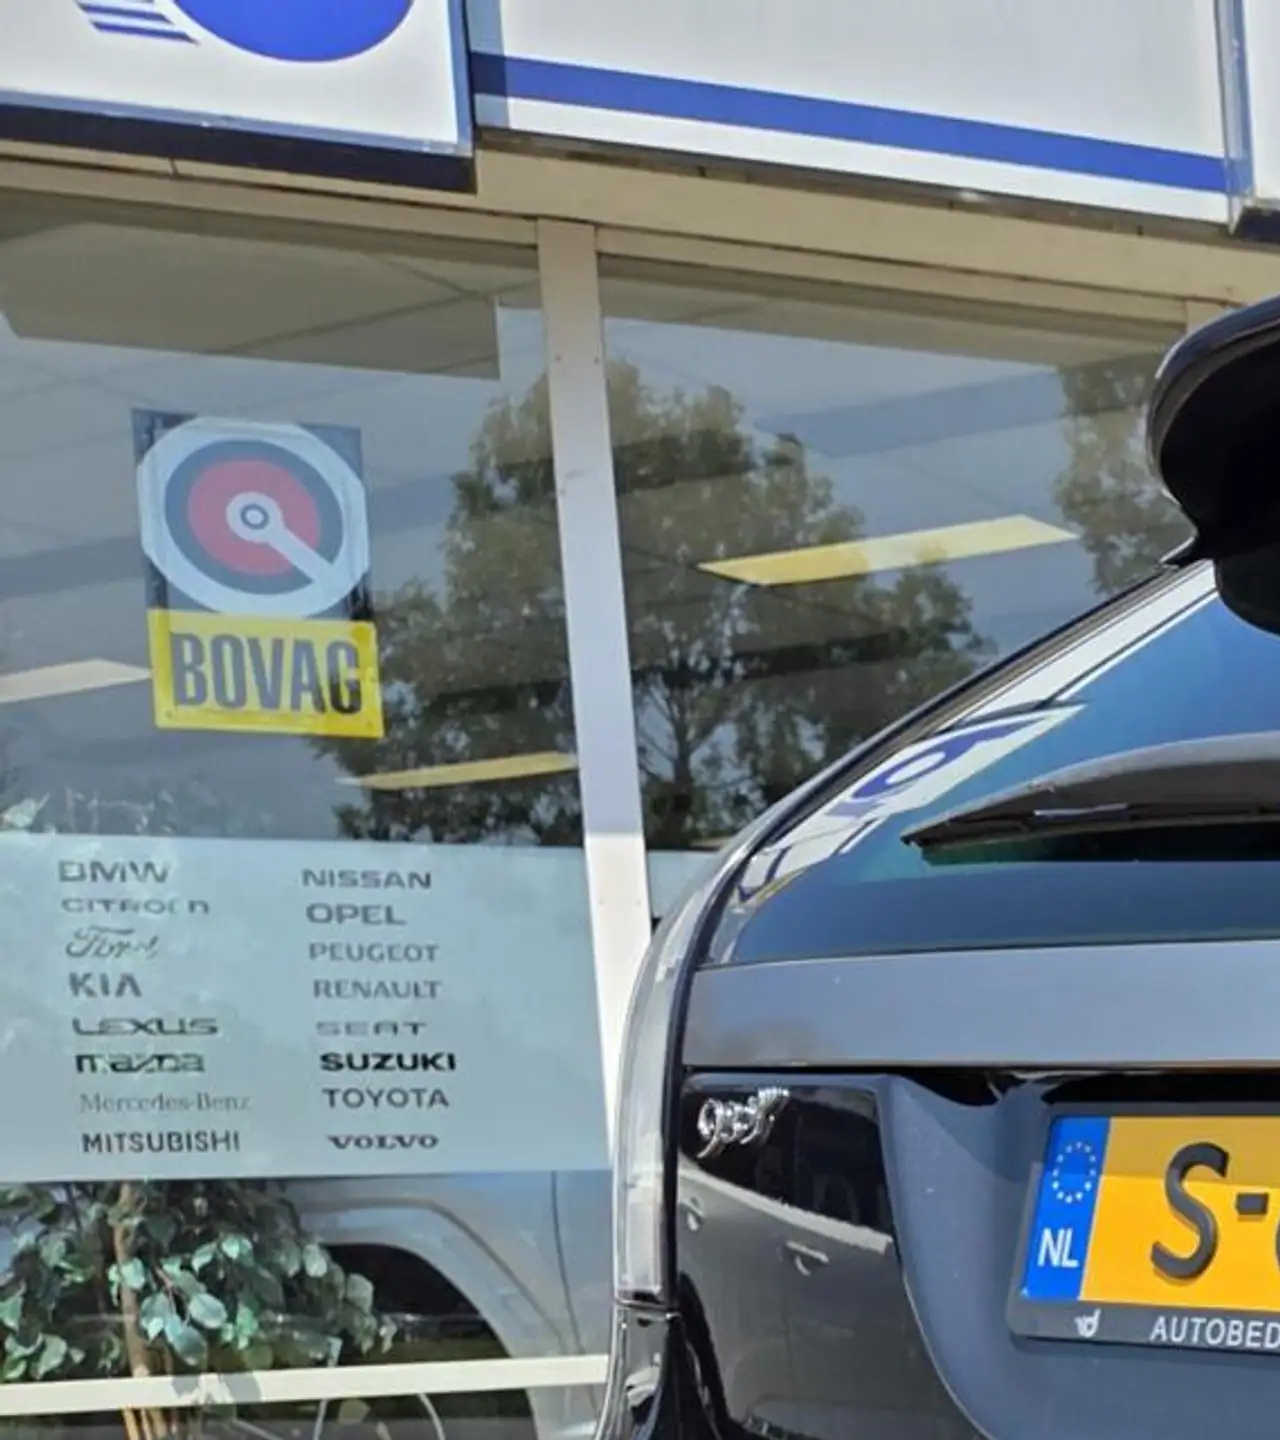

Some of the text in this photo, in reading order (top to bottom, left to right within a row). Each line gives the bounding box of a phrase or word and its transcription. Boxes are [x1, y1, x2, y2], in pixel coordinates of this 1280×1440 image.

[169, 631, 363, 715] BOVAG
[58, 860, 169, 883] BMW
[302, 869, 432, 889] NISSAN
[306, 903, 407, 926] OPEL
[309, 942, 439, 963] PEUGEOT
[69, 972, 142, 998] KIA
[313, 979, 442, 1000] RENAULT
[72, 1017, 218, 1036] LEXUS
[316, 1020, 428, 1037] SEAT
[319, 1052, 457, 1072] SUZUKI
[79, 1092, 252, 1113] Mercedes-Benz
[322, 1087, 449, 1109] TOYOTA
[82, 1130, 241, 1153] MITSUBISHI
[326, 1133, 440, 1150] VOLVO
[1037, 1226, 1079, 1269] NL
